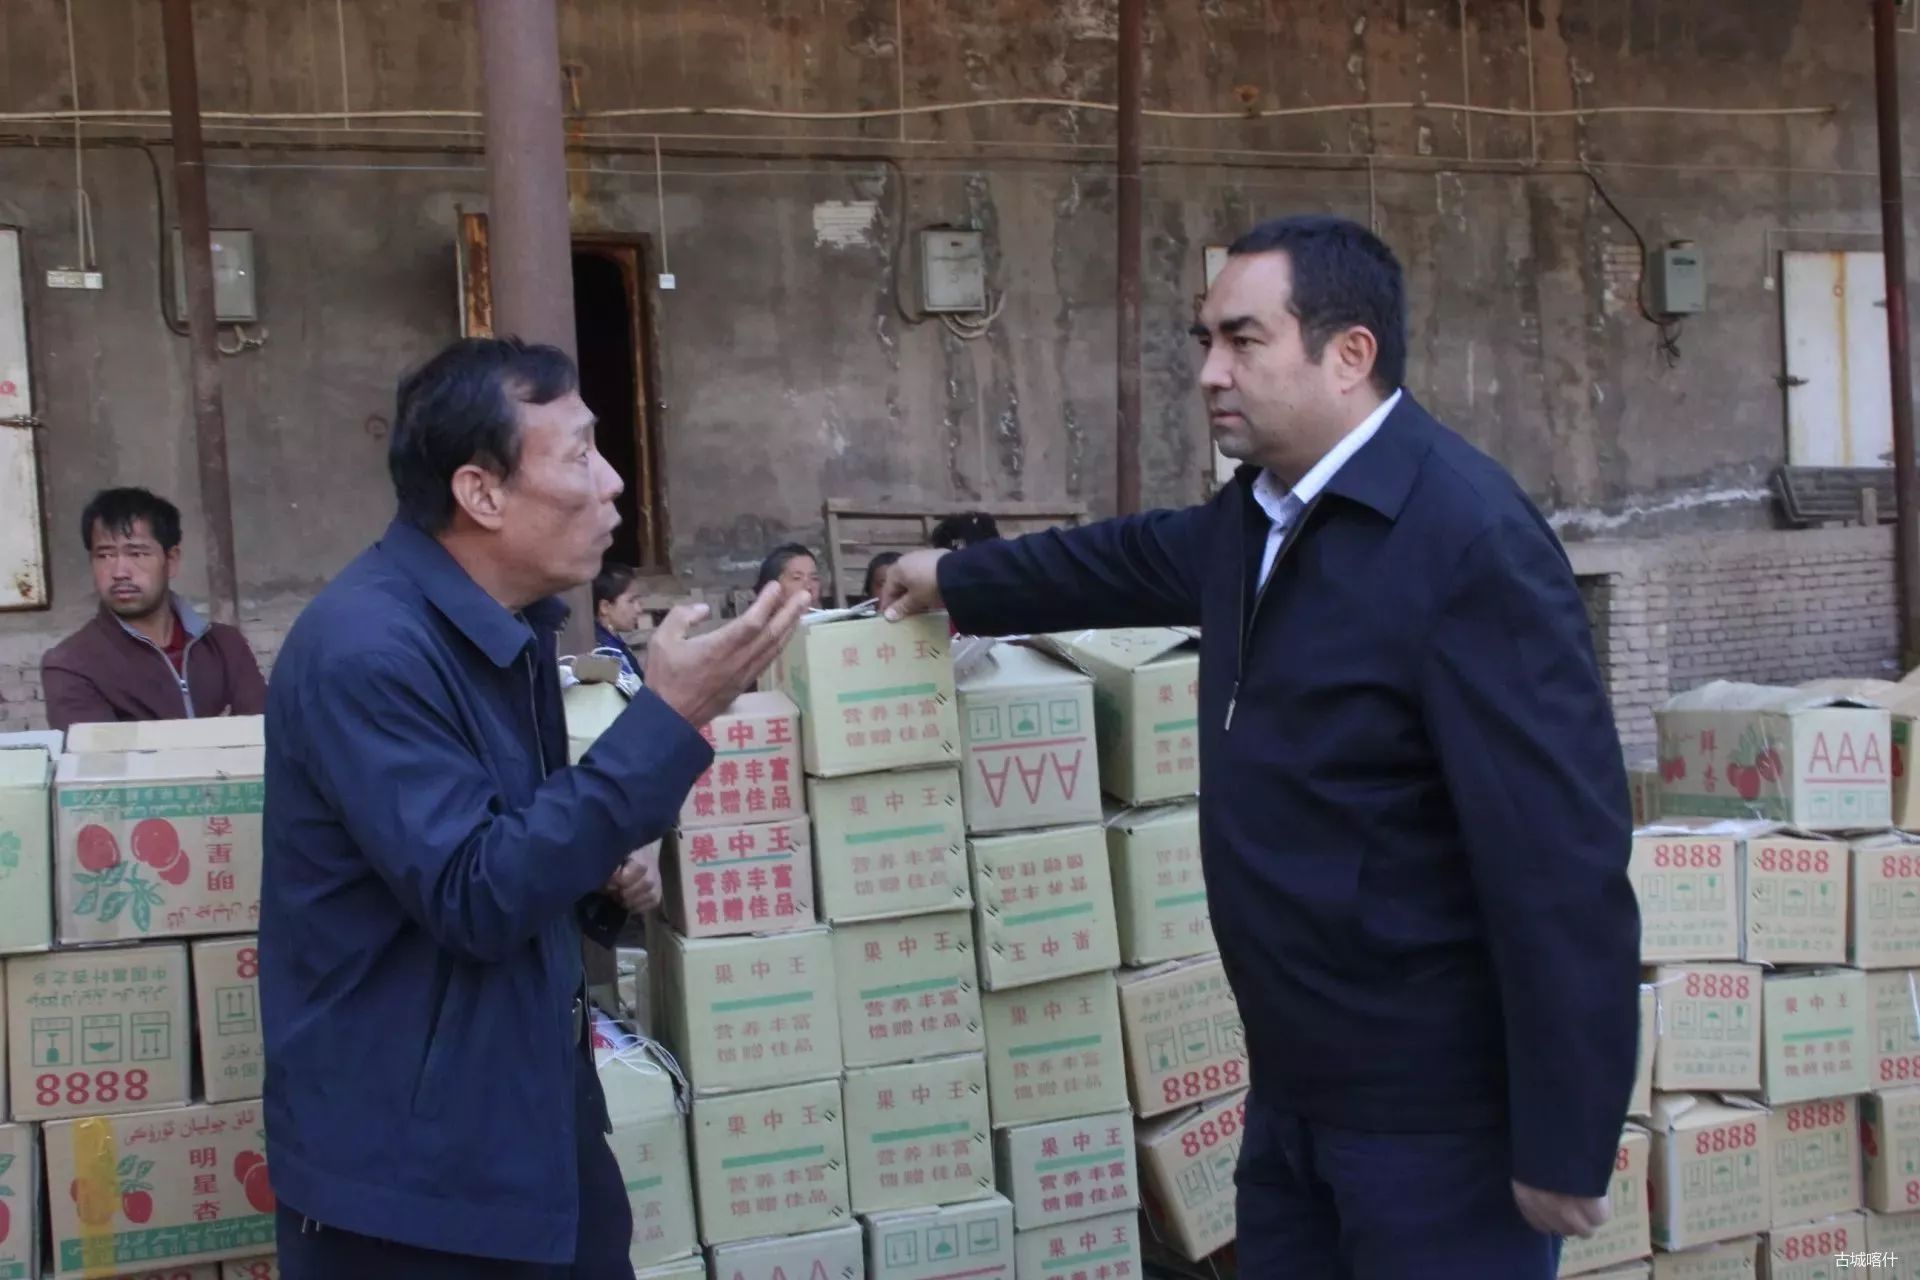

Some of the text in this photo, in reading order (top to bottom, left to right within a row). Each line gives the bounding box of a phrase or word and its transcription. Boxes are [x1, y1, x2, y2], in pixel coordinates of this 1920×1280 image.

[1809, 732, 1884, 774] AAA
[977, 749, 1082, 808] AAA
[690, 827, 792, 864] 果中王
[1655, 844, 1721, 868] 8888
[1761, 847, 1829, 873] 8888
[864, 931, 950, 962] 果中王
[715, 956, 806, 984] 果中王
[1686, 972, 1750, 999] 8888
[36, 1069, 149, 1106] 8888
[876, 1081, 964, 1110] 果中王
[1162, 1059, 1241, 1104] 8888
[728, 1105, 821, 1138] 果中王
[1787, 1100, 1846, 1132] 8888
[1041, 1128, 1122, 1158] 果中王
[1696, 1123, 1756, 1154] 8888
[190, 1147, 220, 1220] 明星杏
[1050, 1225, 1127, 1257] 果中王
[1785, 1228, 1847, 1261] 8888
